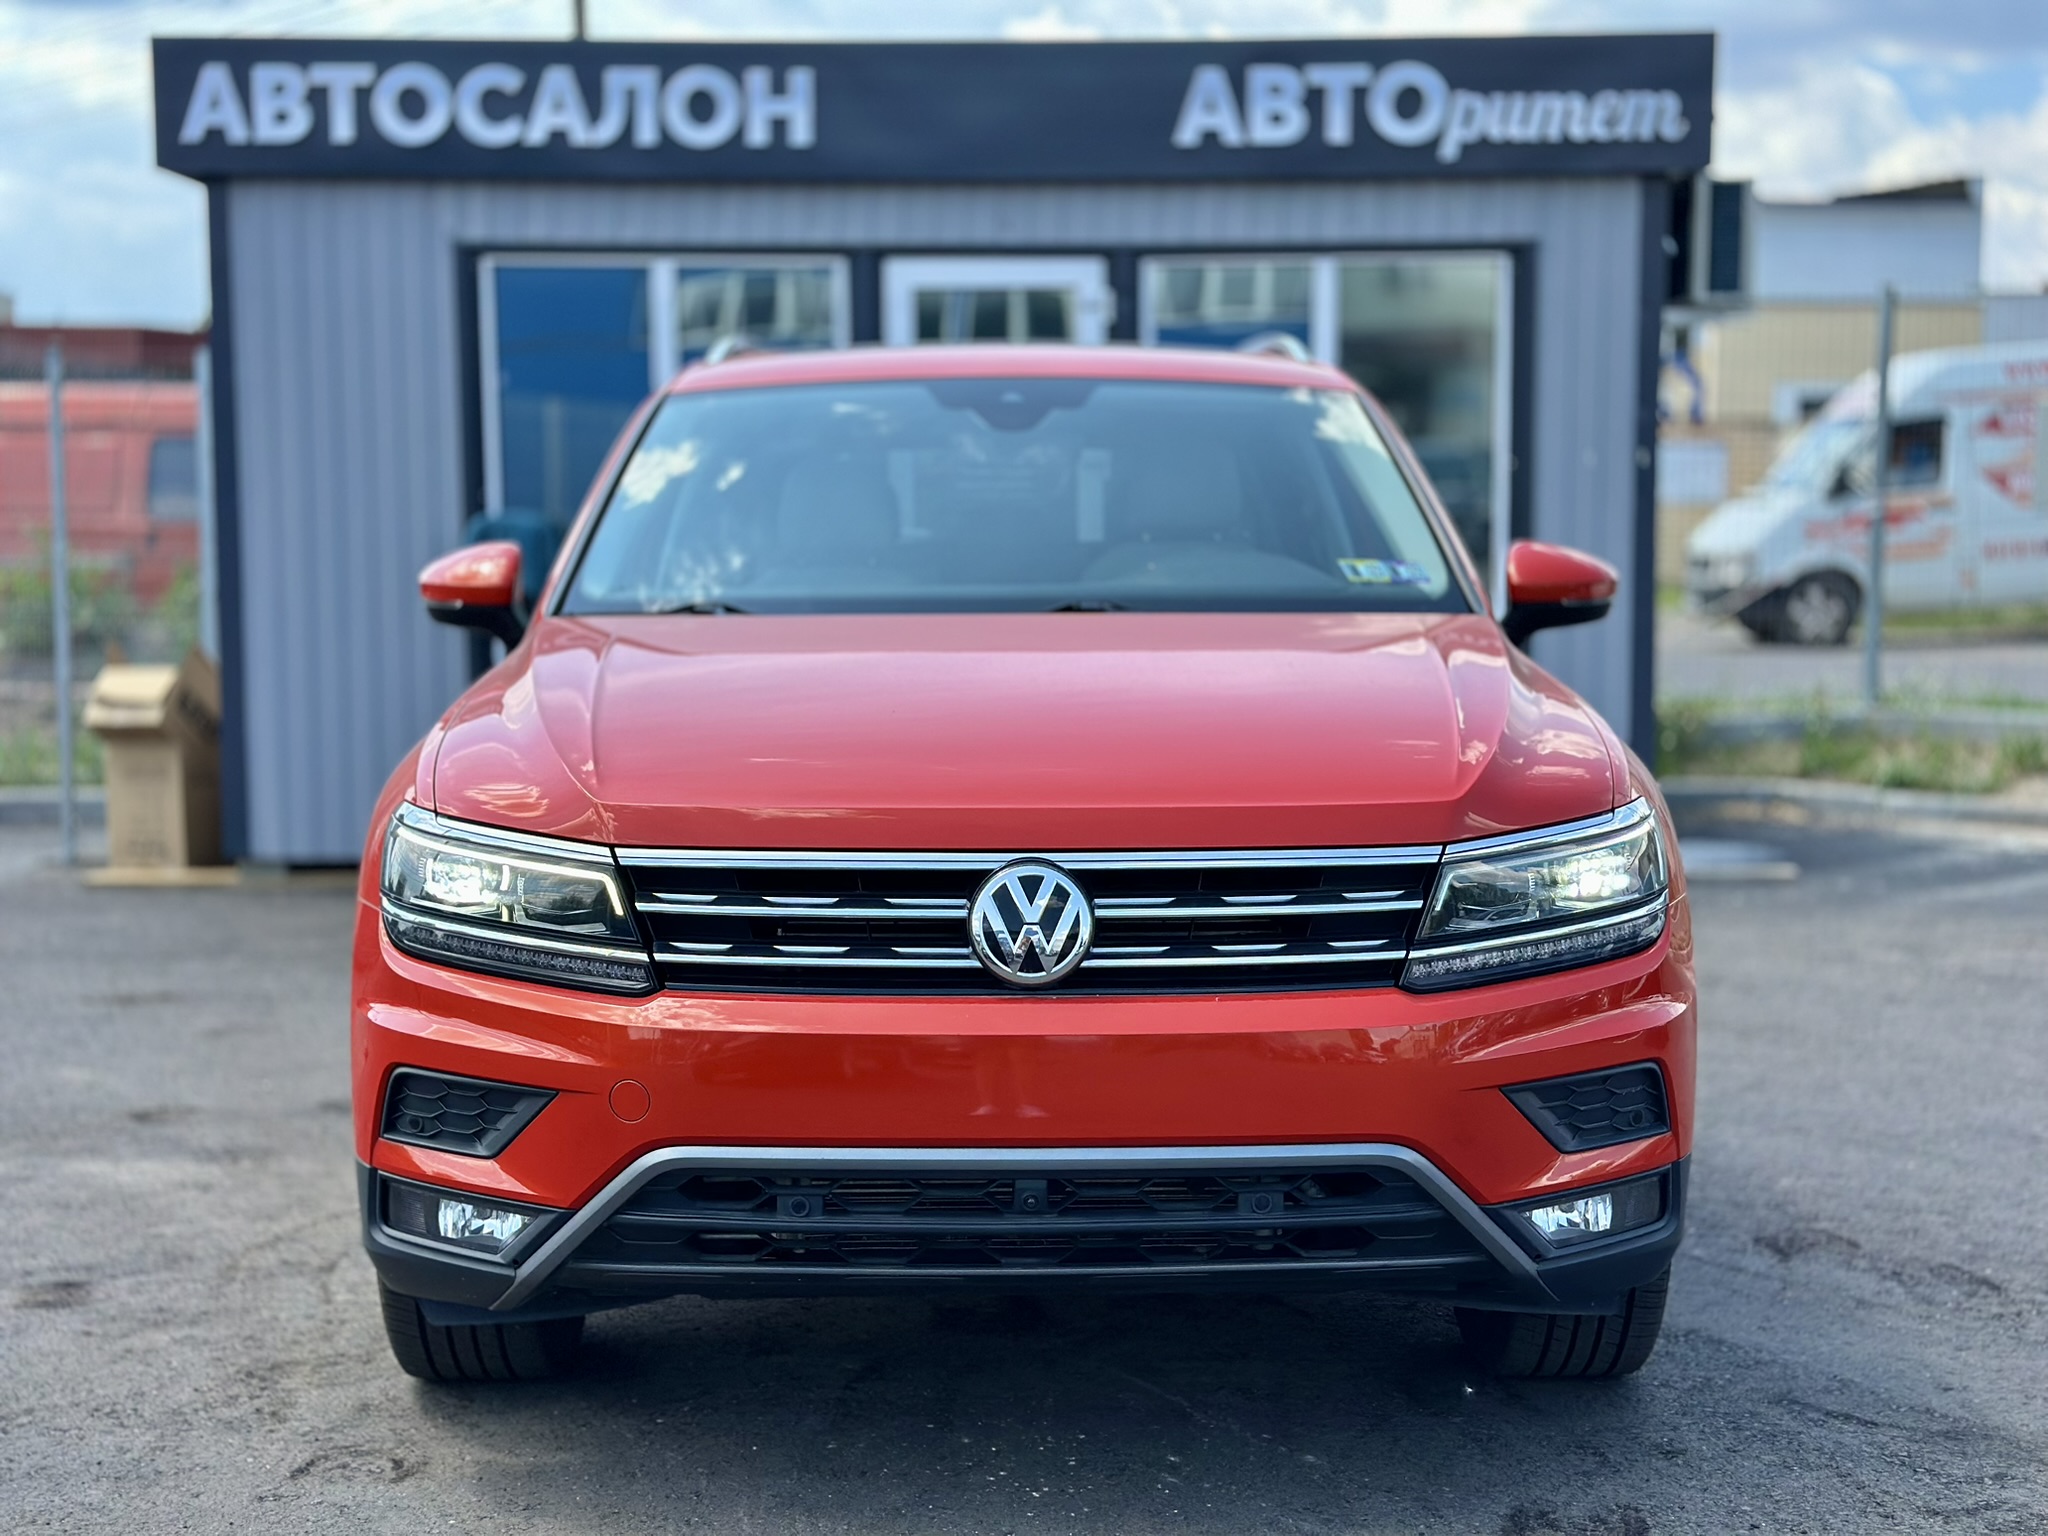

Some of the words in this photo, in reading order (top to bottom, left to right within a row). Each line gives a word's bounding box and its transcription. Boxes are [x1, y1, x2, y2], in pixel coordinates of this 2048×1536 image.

[178, 60, 818, 150] АВТОСАЛОН
[1170, 59, 1691, 164] АВТОритет
[974, 866, 1088, 980] VW
